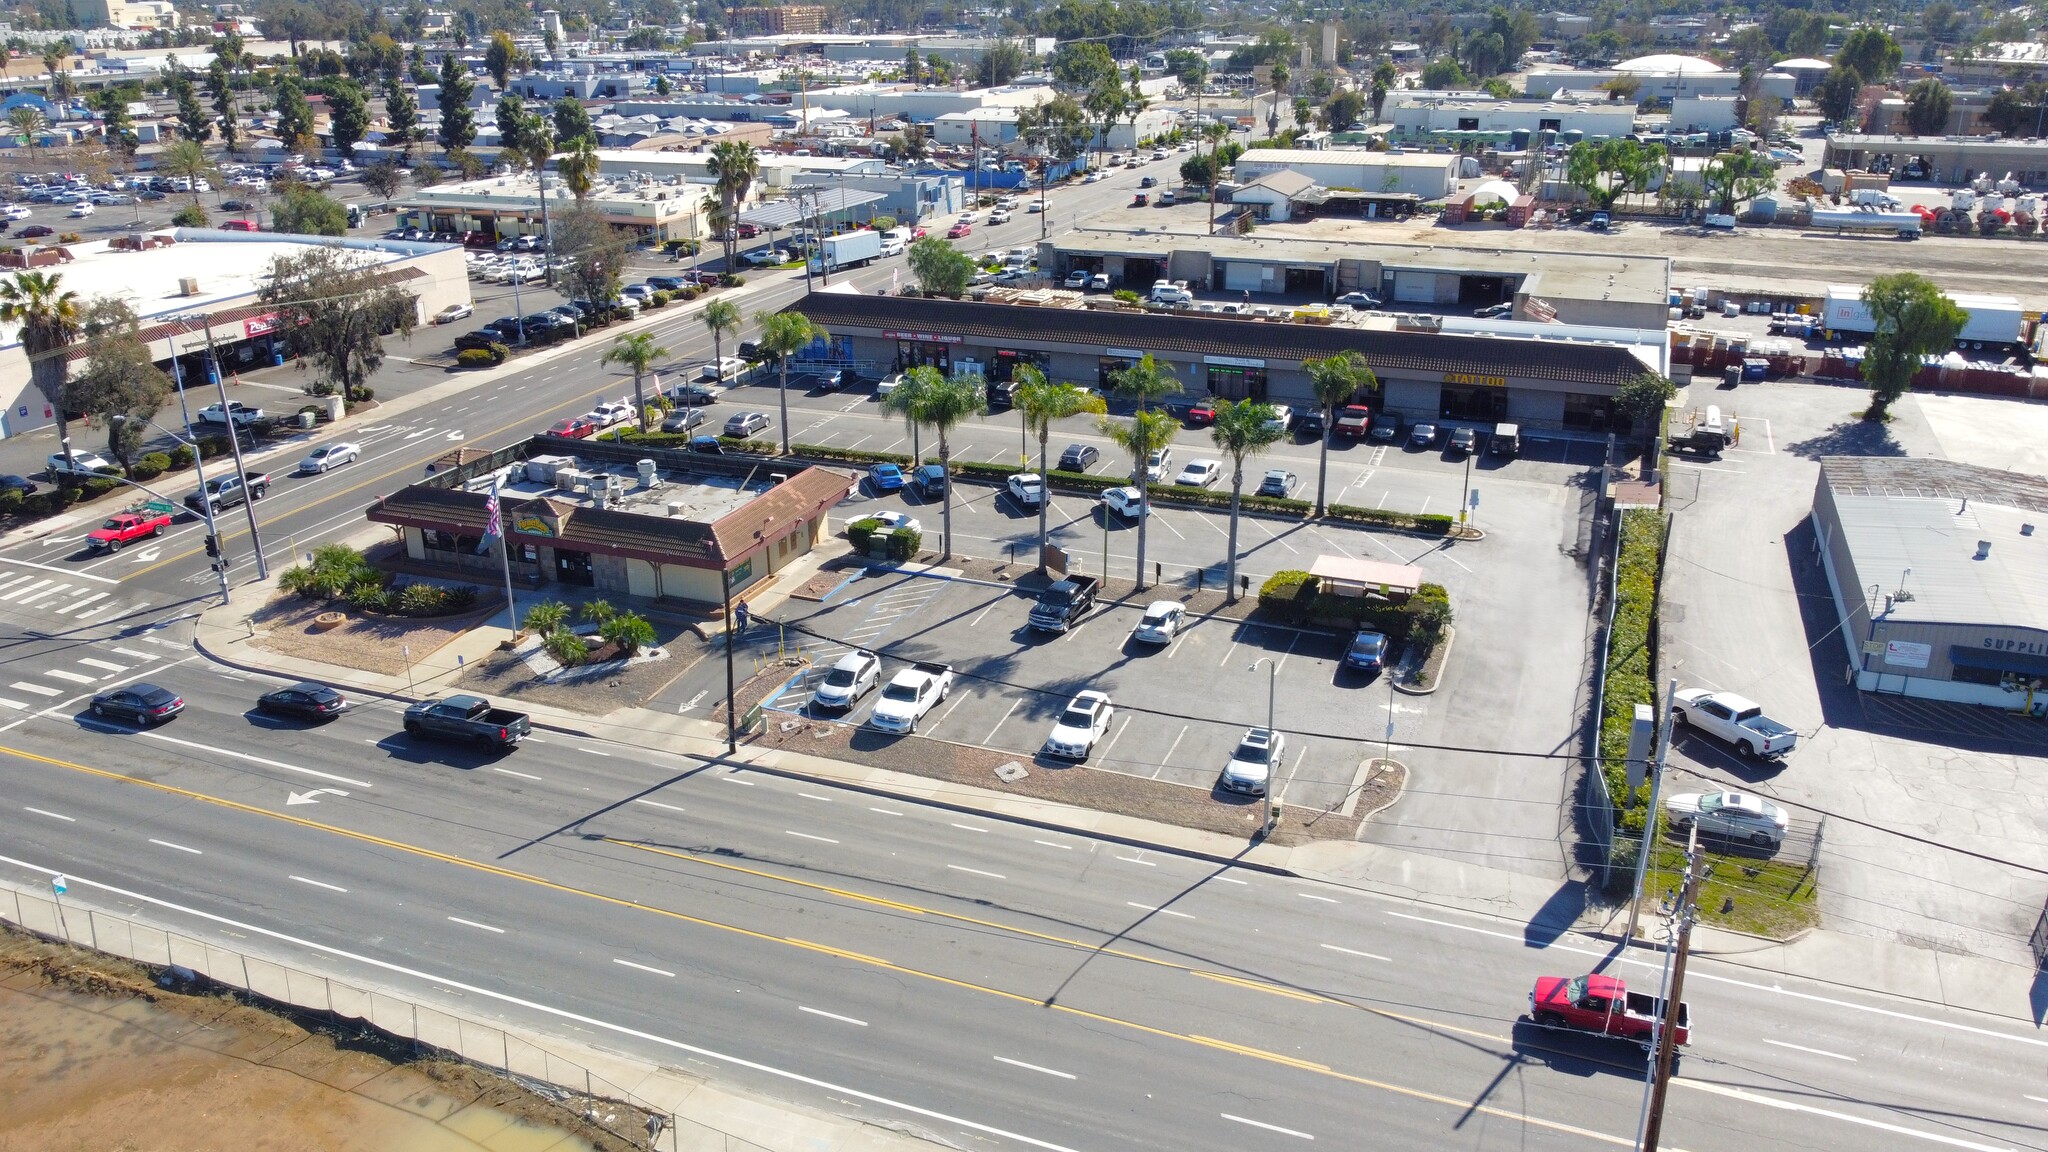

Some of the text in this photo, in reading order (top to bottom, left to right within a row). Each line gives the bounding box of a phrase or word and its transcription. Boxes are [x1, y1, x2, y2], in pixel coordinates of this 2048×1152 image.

[248, 321, 267, 331] Pep
[1454, 374, 1505, 387] TATTOO
[1864, 641, 1884, 650] STOP
